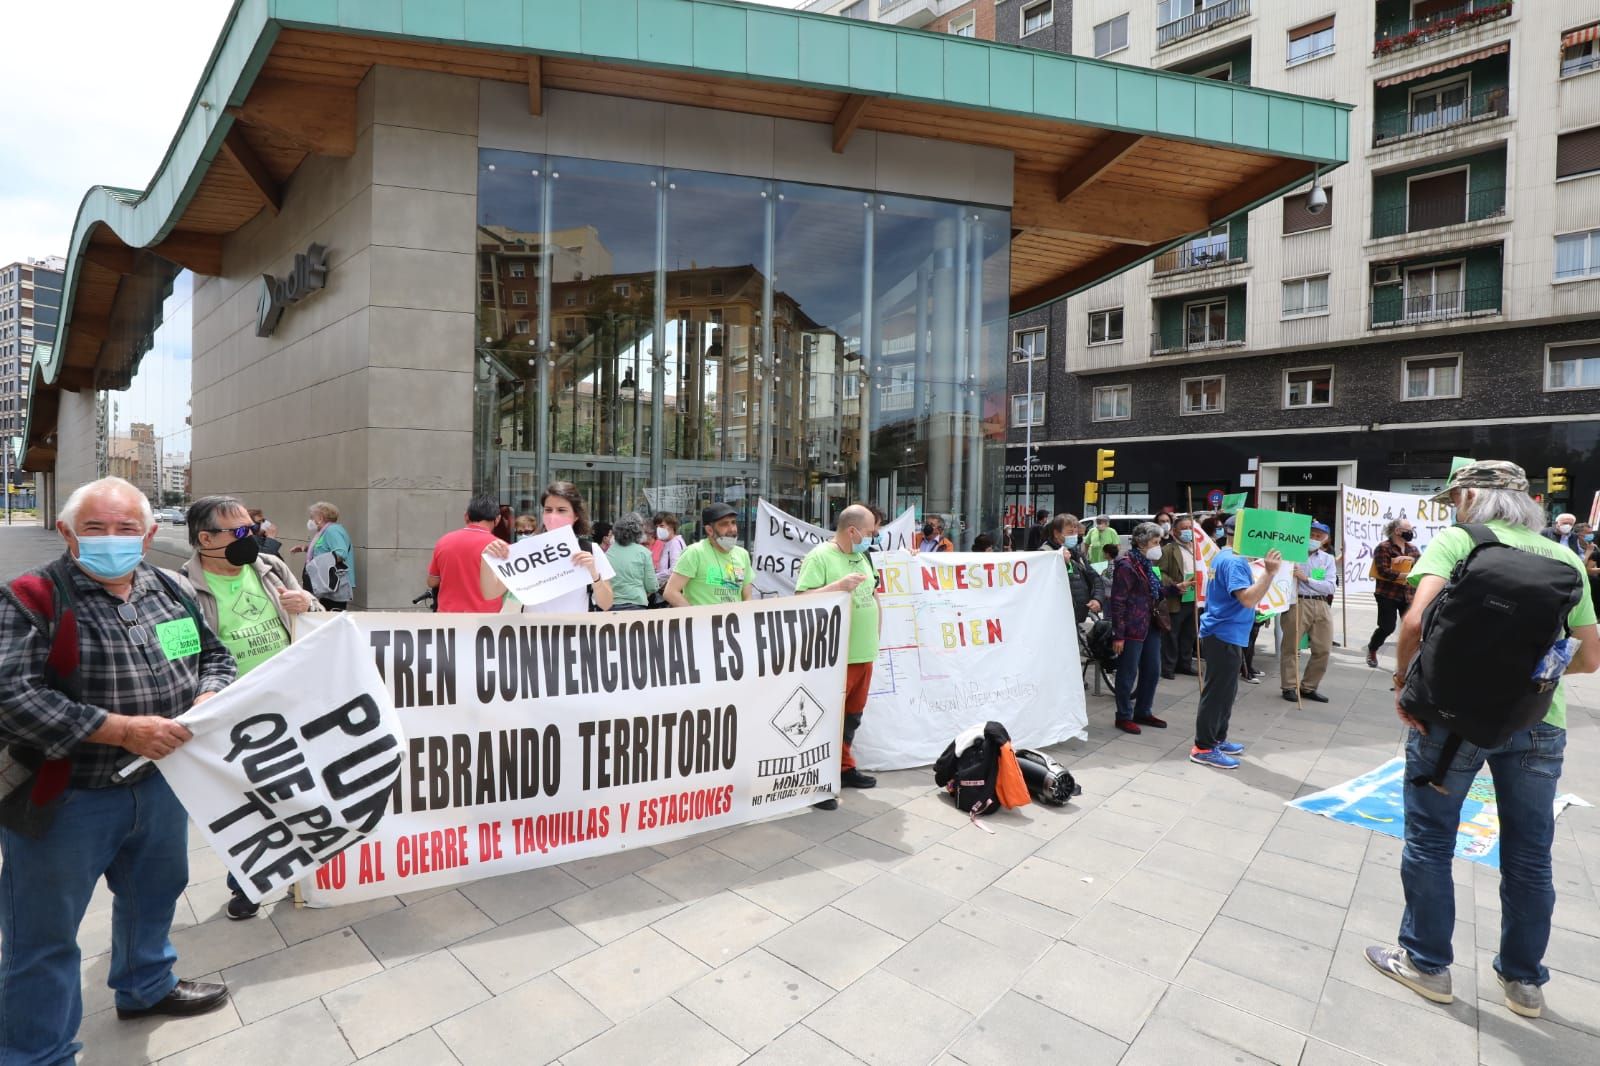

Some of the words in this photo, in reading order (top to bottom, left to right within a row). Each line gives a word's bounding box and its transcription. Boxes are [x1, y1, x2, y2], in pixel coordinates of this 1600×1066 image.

[1247, 529, 1305, 545] CANFRANC
[497, 543, 572, 578] MORÉS
[756, 555, 785, 573] LAS
[921, 560, 1028, 591] NUESTRO
[370, 627, 457, 709] TREN
[475, 616, 701, 704] CONVENCIONAL
[711, 612, 744, 682] ES
[754, 605, 842, 678] FUTURO
[223, 713, 316, 804] QUE
[578, 703, 738, 791] TERRITORIO
[772, 767, 820, 792] MONZÓN
[752, 795, 763, 807] NO
[765, 789, 797, 804] PIERDAS
[315, 848, 346, 890] NO
[358, 841, 385, 885] AL
[396, 825, 469, 878] CIERRE
[478, 821, 503, 863] DE
[512, 805, 610, 855] TAQUILLAS
[620, 802, 631, 834] Y
[637, 784, 734, 830] ESTACIONES
